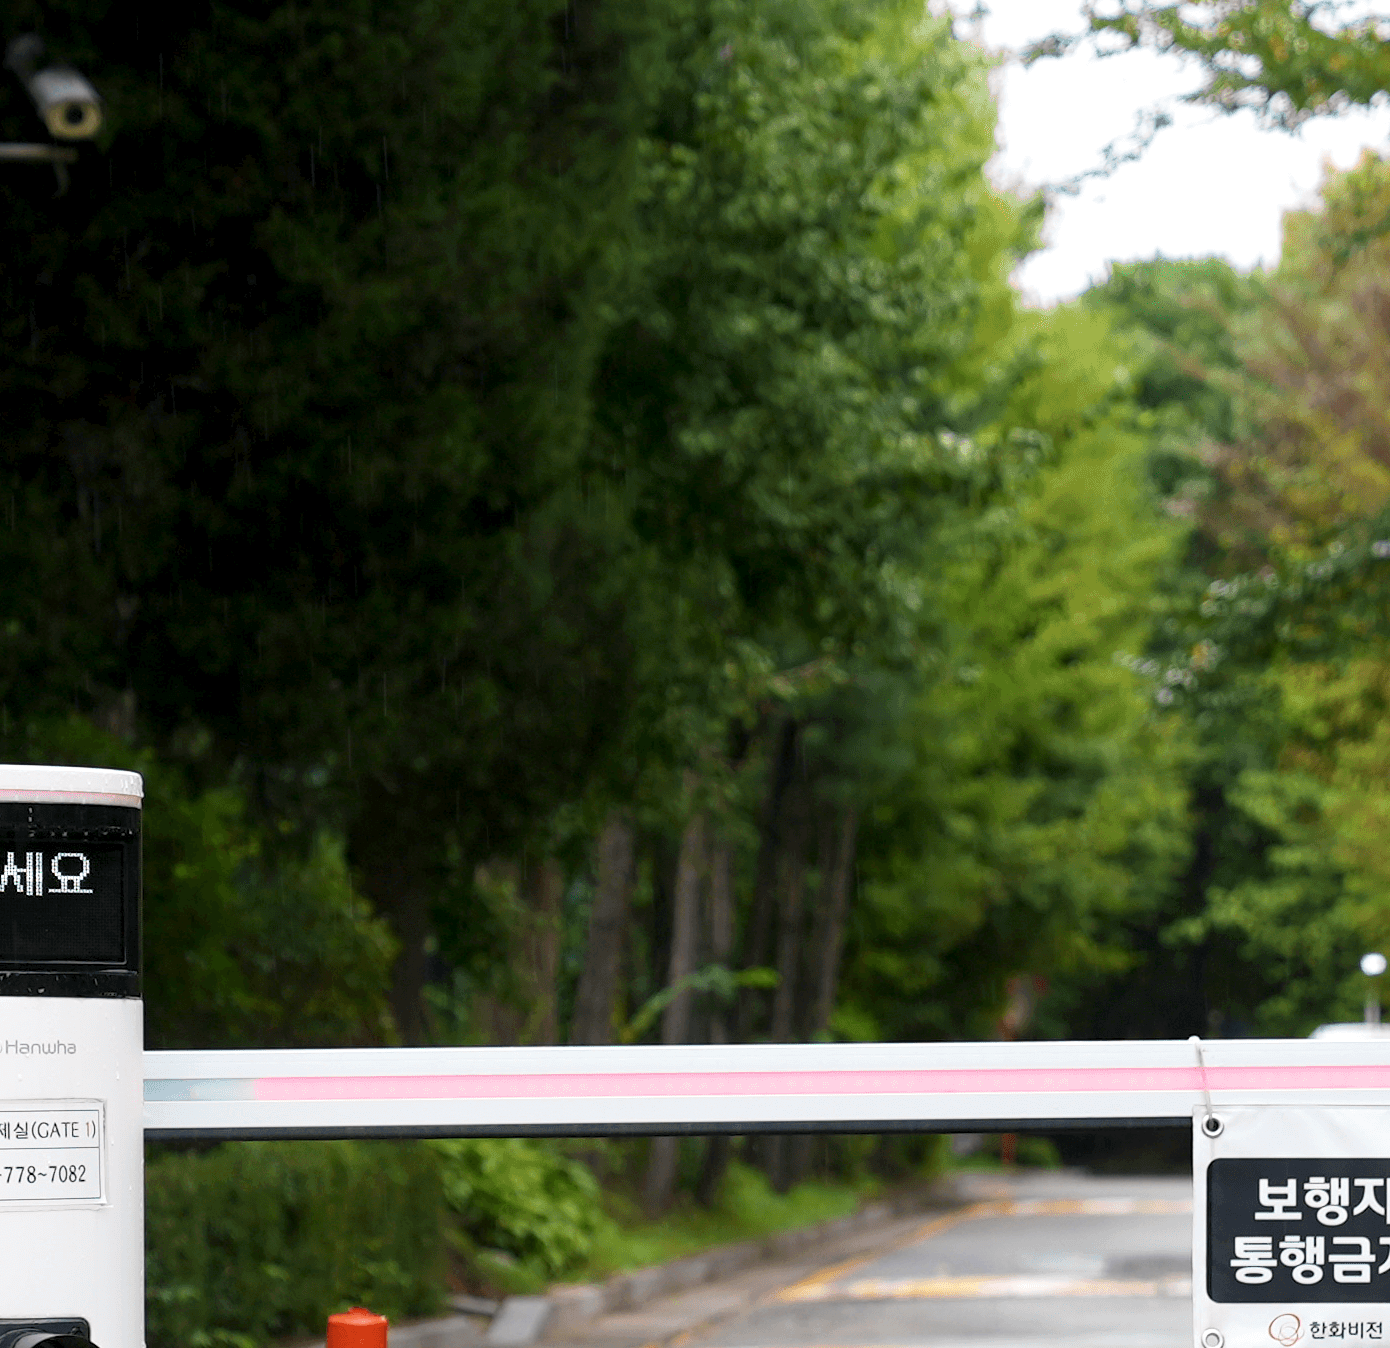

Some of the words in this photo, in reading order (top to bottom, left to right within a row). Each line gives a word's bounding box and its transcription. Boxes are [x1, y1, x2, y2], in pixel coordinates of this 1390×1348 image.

[5, 1039, 77, 1055] Hanwha
[85, 1119, 96, 1139] 1)
[1309, 1320, 1384, 1340] 한화비전
